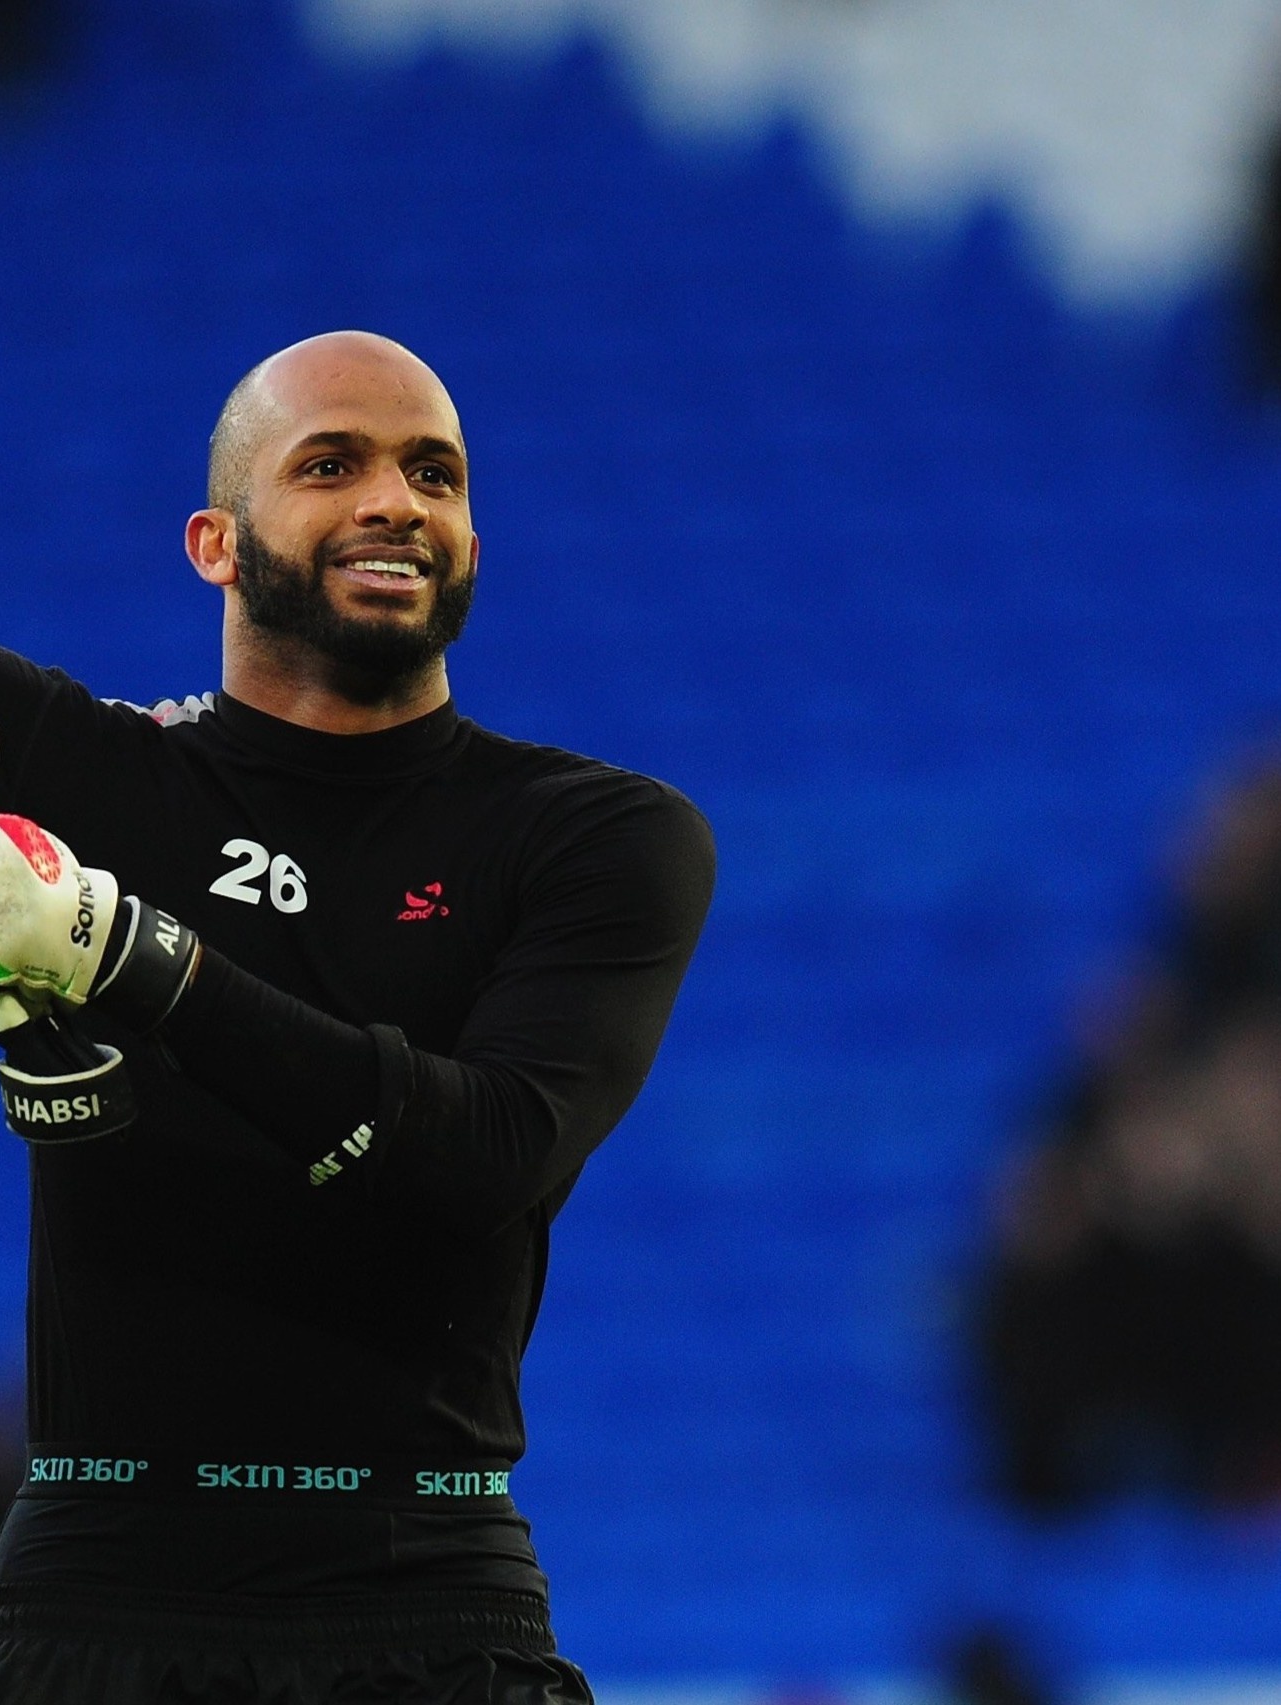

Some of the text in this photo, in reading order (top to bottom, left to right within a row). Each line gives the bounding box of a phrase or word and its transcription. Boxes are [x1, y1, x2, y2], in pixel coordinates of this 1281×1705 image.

[209, 838, 308, 913] 26
[14, 1093, 100, 1124] HABSI
[29, 1458, 74, 1481] SKIN
[197, 1463, 284, 1488] SKIN
[415, 1471, 480, 1495] SKIN
